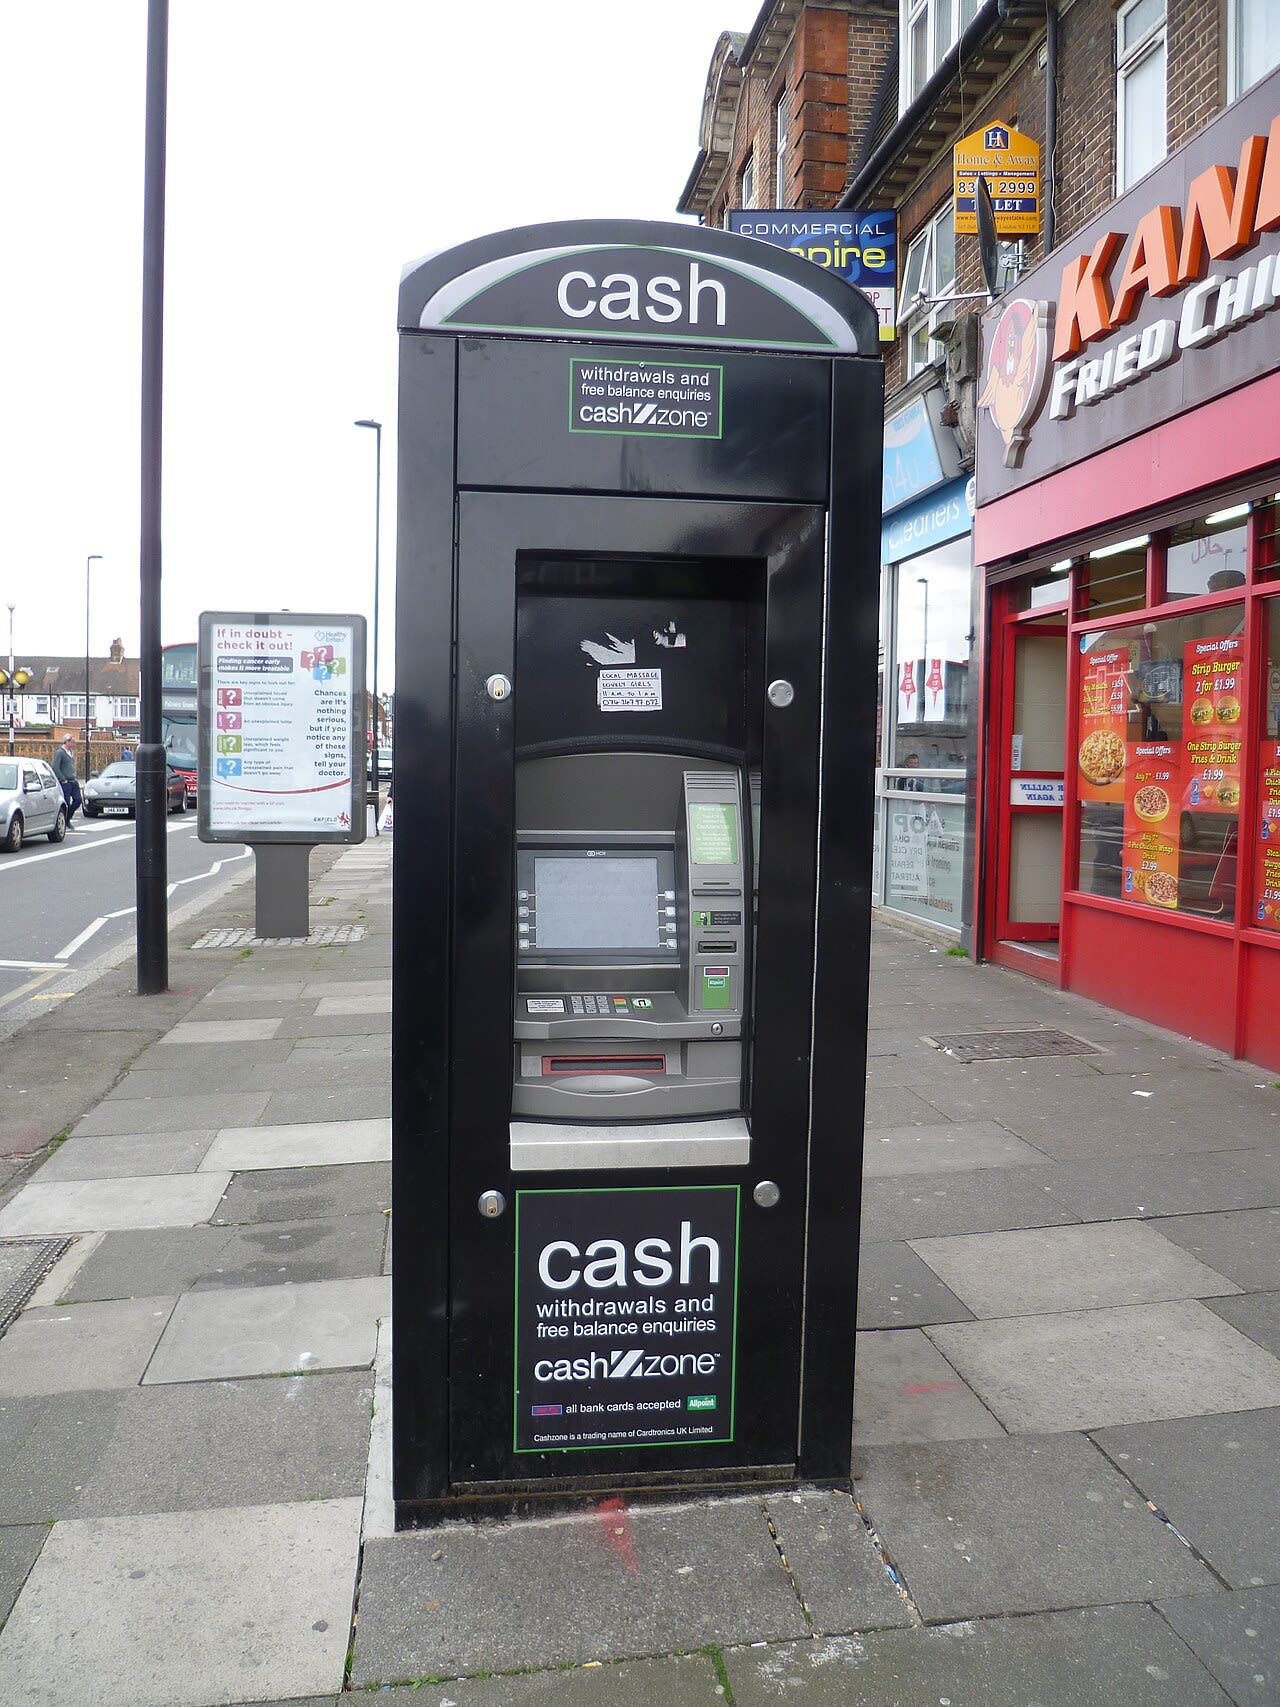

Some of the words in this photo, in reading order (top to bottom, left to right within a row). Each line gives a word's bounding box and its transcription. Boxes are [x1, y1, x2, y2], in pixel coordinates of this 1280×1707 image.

[957, 153, 990, 166] Home
[993, 154, 1002, 166] &
[1006, 154, 1036, 167] Away
[958, 181, 994, 194] 831
[999, 181, 1035, 194] 2999
[995, 199, 1023, 211] LET
[739, 223, 886, 236] COMMERCIAL
[789, 240, 886, 269] pire
[557, 262, 726, 326] cash
[580, 366, 675, 384] withdrawals
[680, 373, 709, 386] and
[1049, 319, 1176, 421] FRIED
[581, 383, 604, 396] free
[608, 385, 654, 398] balance
[657, 388, 711, 402] enquiries
[217, 628, 226, 638] If
[230, 628, 241, 638] in
[245, 629, 282, 639] doubt
[217, 640, 252, 650] check
[256, 640, 265, 650] it
[268, 641, 293, 650] out!
[1195, 641, 1219, 654] Special
[1219, 640, 1238, 652] Offers
[218, 657, 241, 665] Finding
[1191, 663, 1211, 676] Strip
[1212, 661, 1241, 675] Burger
[1195, 681, 1201, 693] 2
[1200, 680, 1213, 694] for
[1213, 678, 1236, 691] £1.99
[314, 689, 347, 697] Chances
[335, 698, 347, 706] it's
[316, 708, 346, 716] nothing
[316, 717, 347, 725] serious,
[309, 725, 323, 733] but
[325, 725, 331, 733] if
[332, 726, 347, 735] you
[332, 735, 346, 743] any
[325, 743, 346, 751] these
[1135, 746, 1155, 756] Special
[1155, 745, 1171, 756] Offers
[1187, 742, 1200, 751] One
[1200, 741, 1217, 752] Strip
[1218, 741, 1242, 753] Burger
[324, 752, 347, 761] signs,
[1191, 754, 1208, 764] Fries
[1209, 755, 1215, 763] &
[1216, 754, 1237, 764] Drink
[328, 762, 347, 770] your
[318, 769, 347, 777] doctor.
[1135, 773, 1145, 782] Any
[1155, 772, 1170, 780] £1.99
[1202, 769, 1224, 781] £1.99
[1141, 861, 1158, 871] £2.99
[538, 1220, 720, 1290] cash
[536, 1295, 666, 1318] withdrawals
[674, 1293, 714, 1312] and
[536, 1322, 569, 1338] free
[573, 1319, 638, 1337] balance
[642, 1316, 716, 1338] enquiries
[565, 1404, 578, 1414] all
[580, 1402, 605, 1413] bank
[607, 1401, 634, 1412] cards
[636, 1399, 681, 1411] accepted
[689, 1396, 715, 1408] Allpoint
[533, 1433, 568, 1442] Cashzone
[583, 1431, 607, 1441] trading
[607, 1431, 627, 1439] name
[636, 1428, 675, 1437] Cardtronics
[676, 1427, 687, 1435] UK
[688, 1425, 713, 1434] Limited
